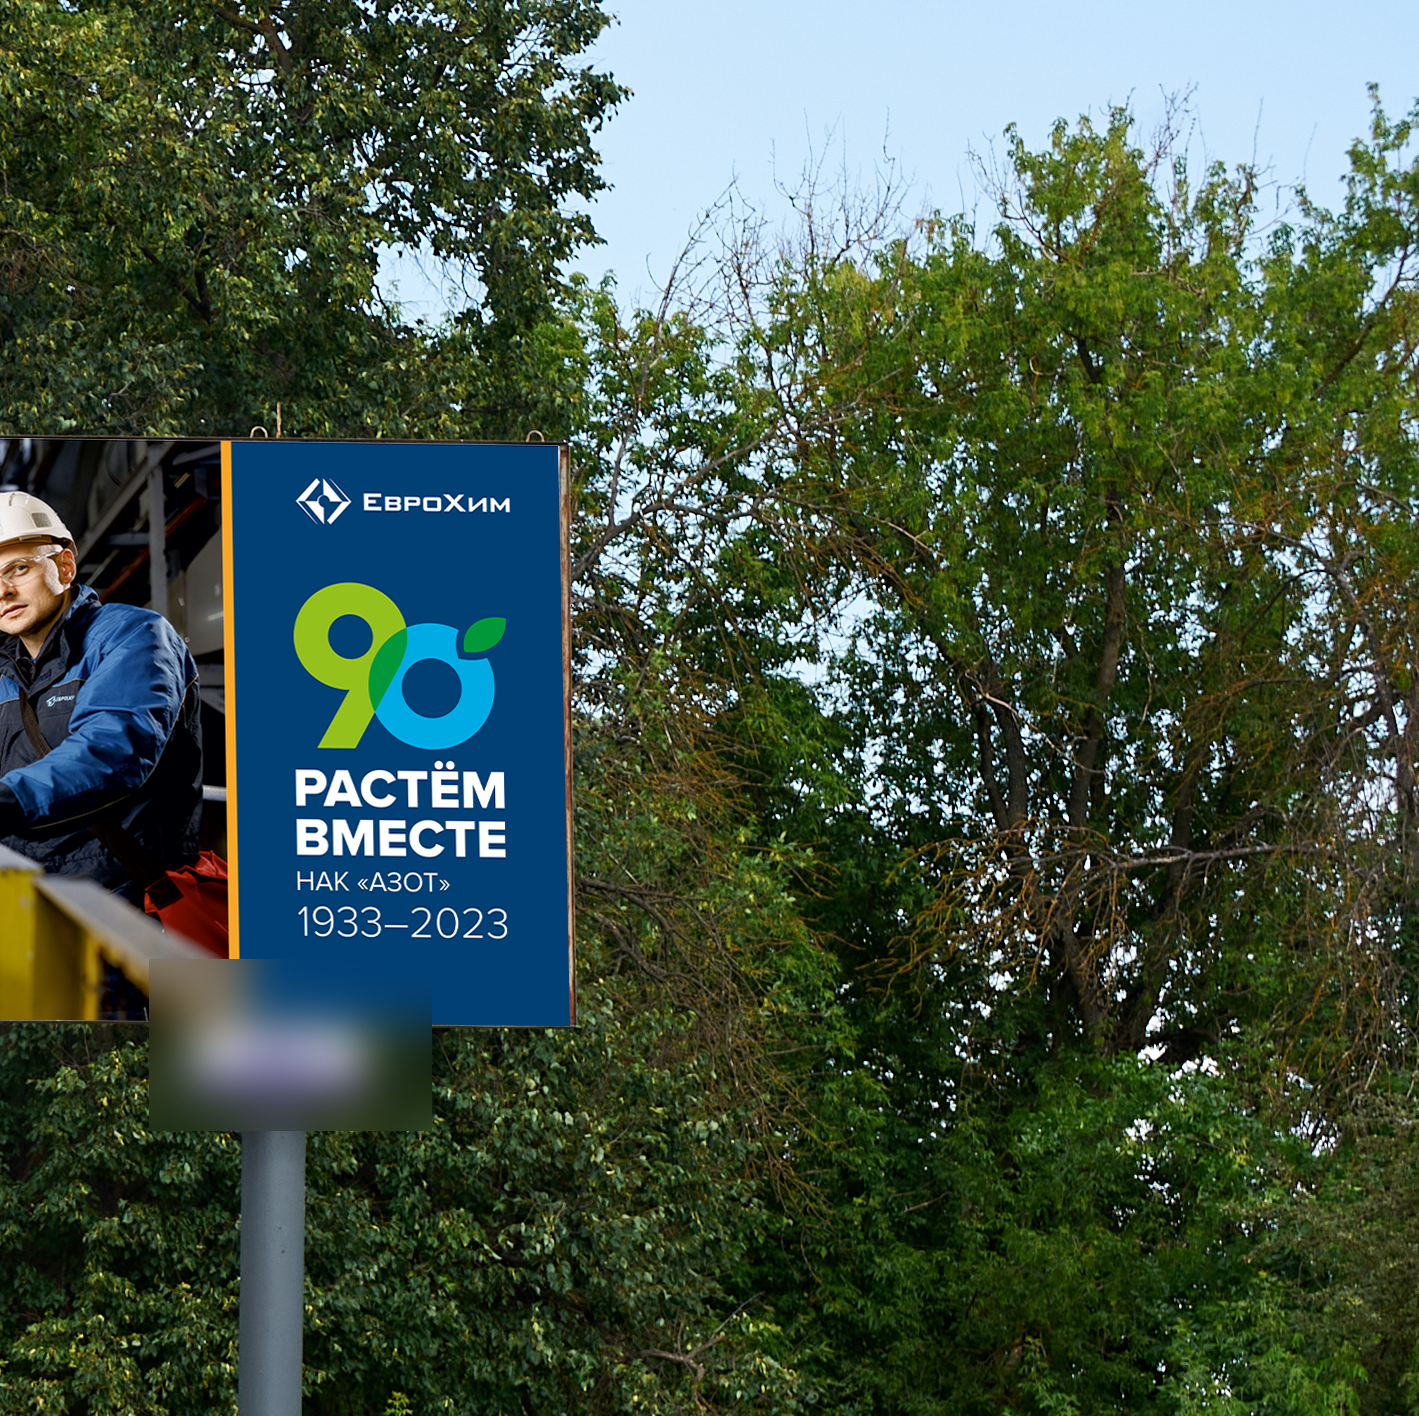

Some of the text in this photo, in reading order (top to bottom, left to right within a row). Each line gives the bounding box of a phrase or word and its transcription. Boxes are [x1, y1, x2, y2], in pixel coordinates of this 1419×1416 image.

[293, 581, 496, 751] 90
[295, 760, 506, 809] РАСТЁМ
[295, 818, 507, 859] ВМЕСТЕ
[296, 870, 451, 893] НАК «АЗОТ»
